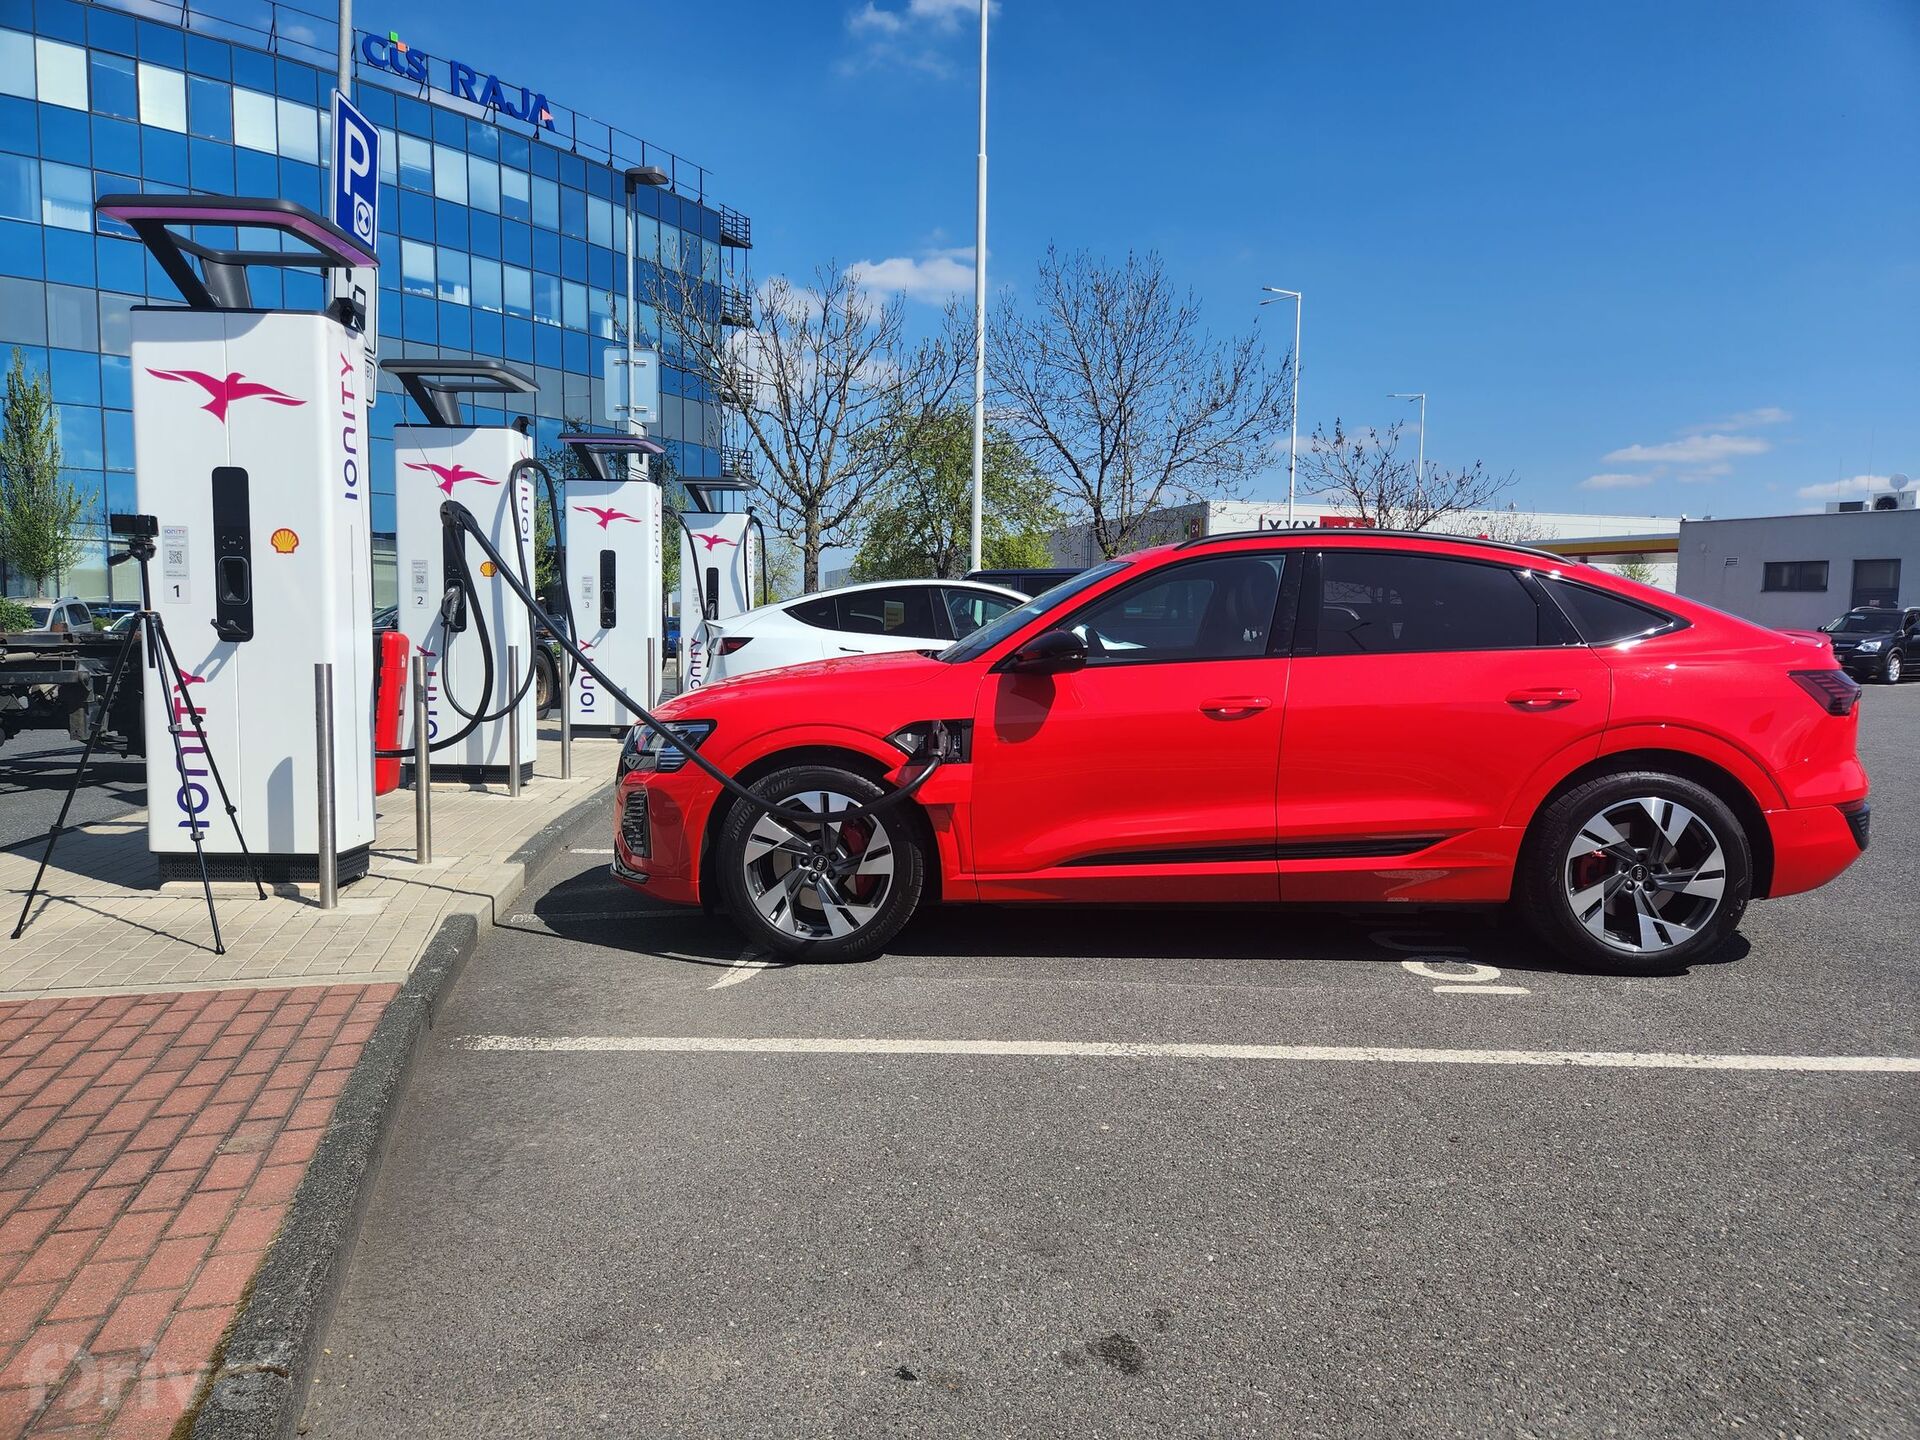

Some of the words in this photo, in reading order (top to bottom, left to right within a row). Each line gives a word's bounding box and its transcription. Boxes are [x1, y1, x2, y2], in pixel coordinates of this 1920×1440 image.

[450, 59, 555, 132] RAJA
[344, 117, 370, 196] P
[340, 351, 358, 501] IONITY
[173, 584, 180, 598] 1
[417, 597, 424, 605] 2
[584, 601, 590, 609] 3
[173, 668, 210, 828] IONITY
